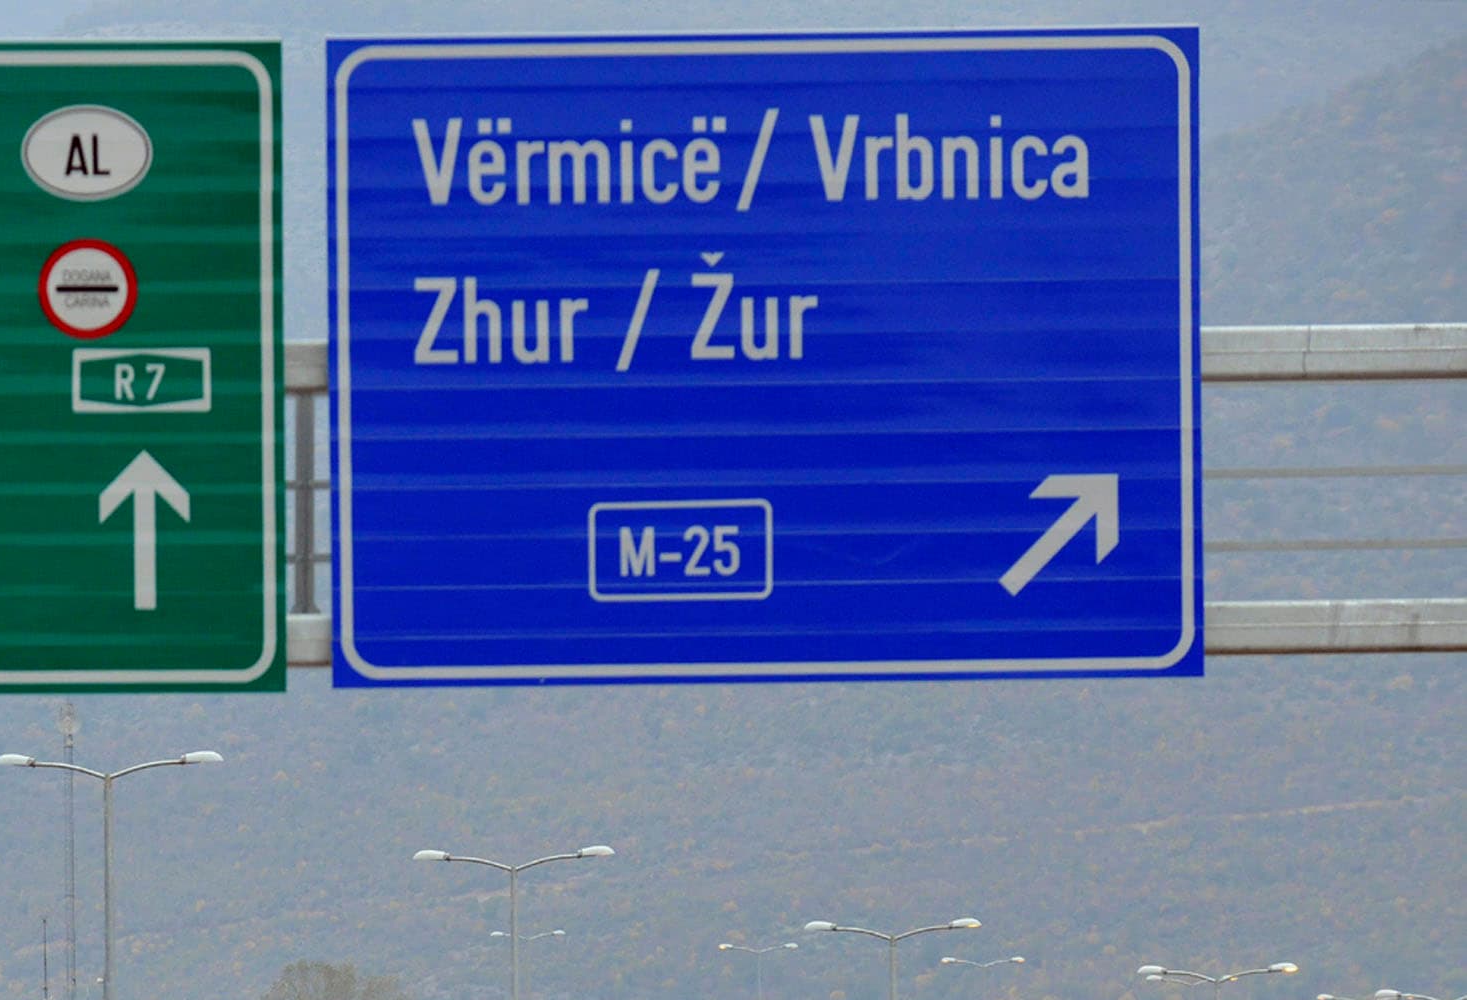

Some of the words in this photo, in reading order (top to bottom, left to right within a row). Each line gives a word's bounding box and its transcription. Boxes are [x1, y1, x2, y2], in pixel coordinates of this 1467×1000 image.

[65, 134, 110, 176] AL
[413, 116, 727, 205] Vërmicë
[737, 108, 779, 211] /
[809, 113, 1089, 201] Vrbnica
[62, 269, 112, 282] DOGANA
[64, 296, 111, 309] CARINA
[413, 276, 588, 364] Zhur
[616, 269, 660, 372] /
[690, 252, 818, 360] Žur
[114, 363, 135, 400] R
[145, 363, 165, 400] 7
[620, 525, 740, 577] M-25
